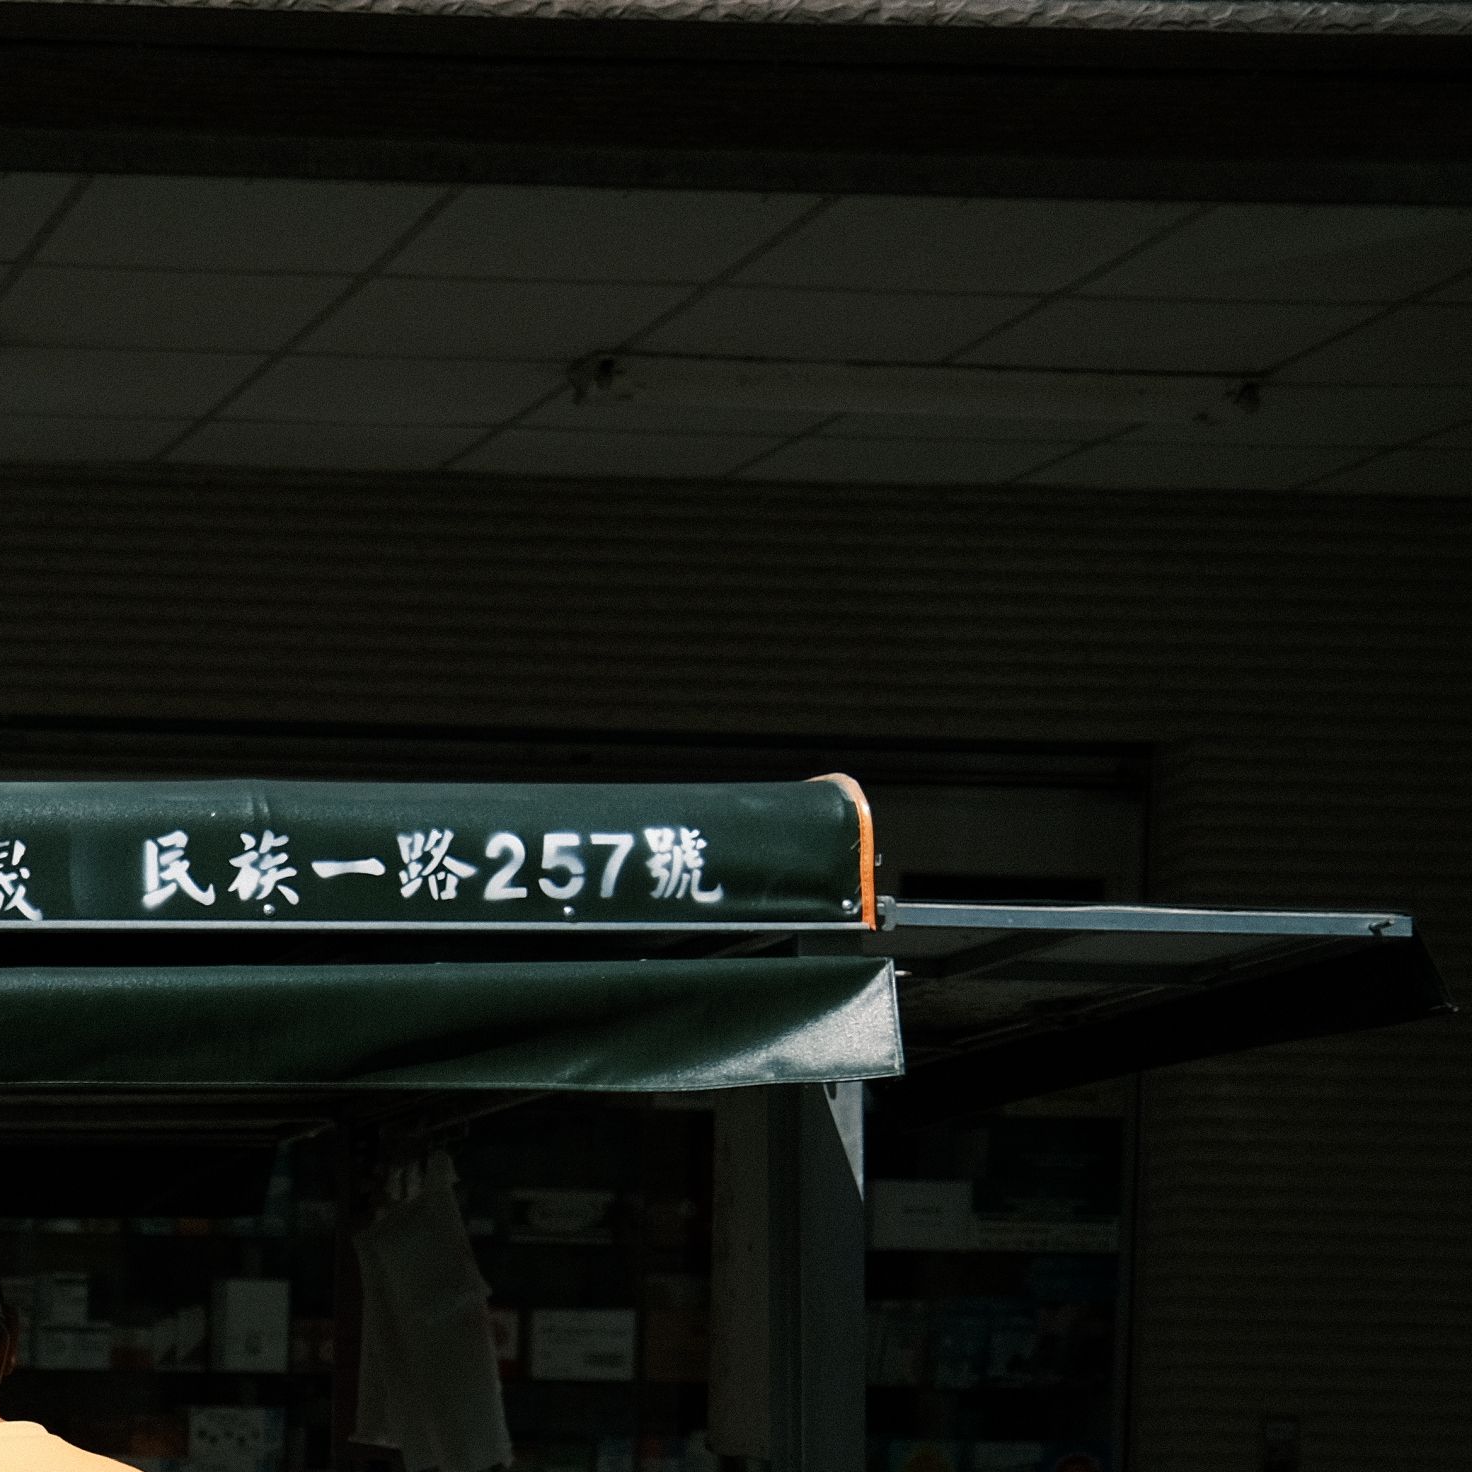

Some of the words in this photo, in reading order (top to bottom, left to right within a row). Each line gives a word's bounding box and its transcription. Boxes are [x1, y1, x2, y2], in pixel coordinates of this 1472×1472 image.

[142, 829, 724, 906] 民族一路257號
